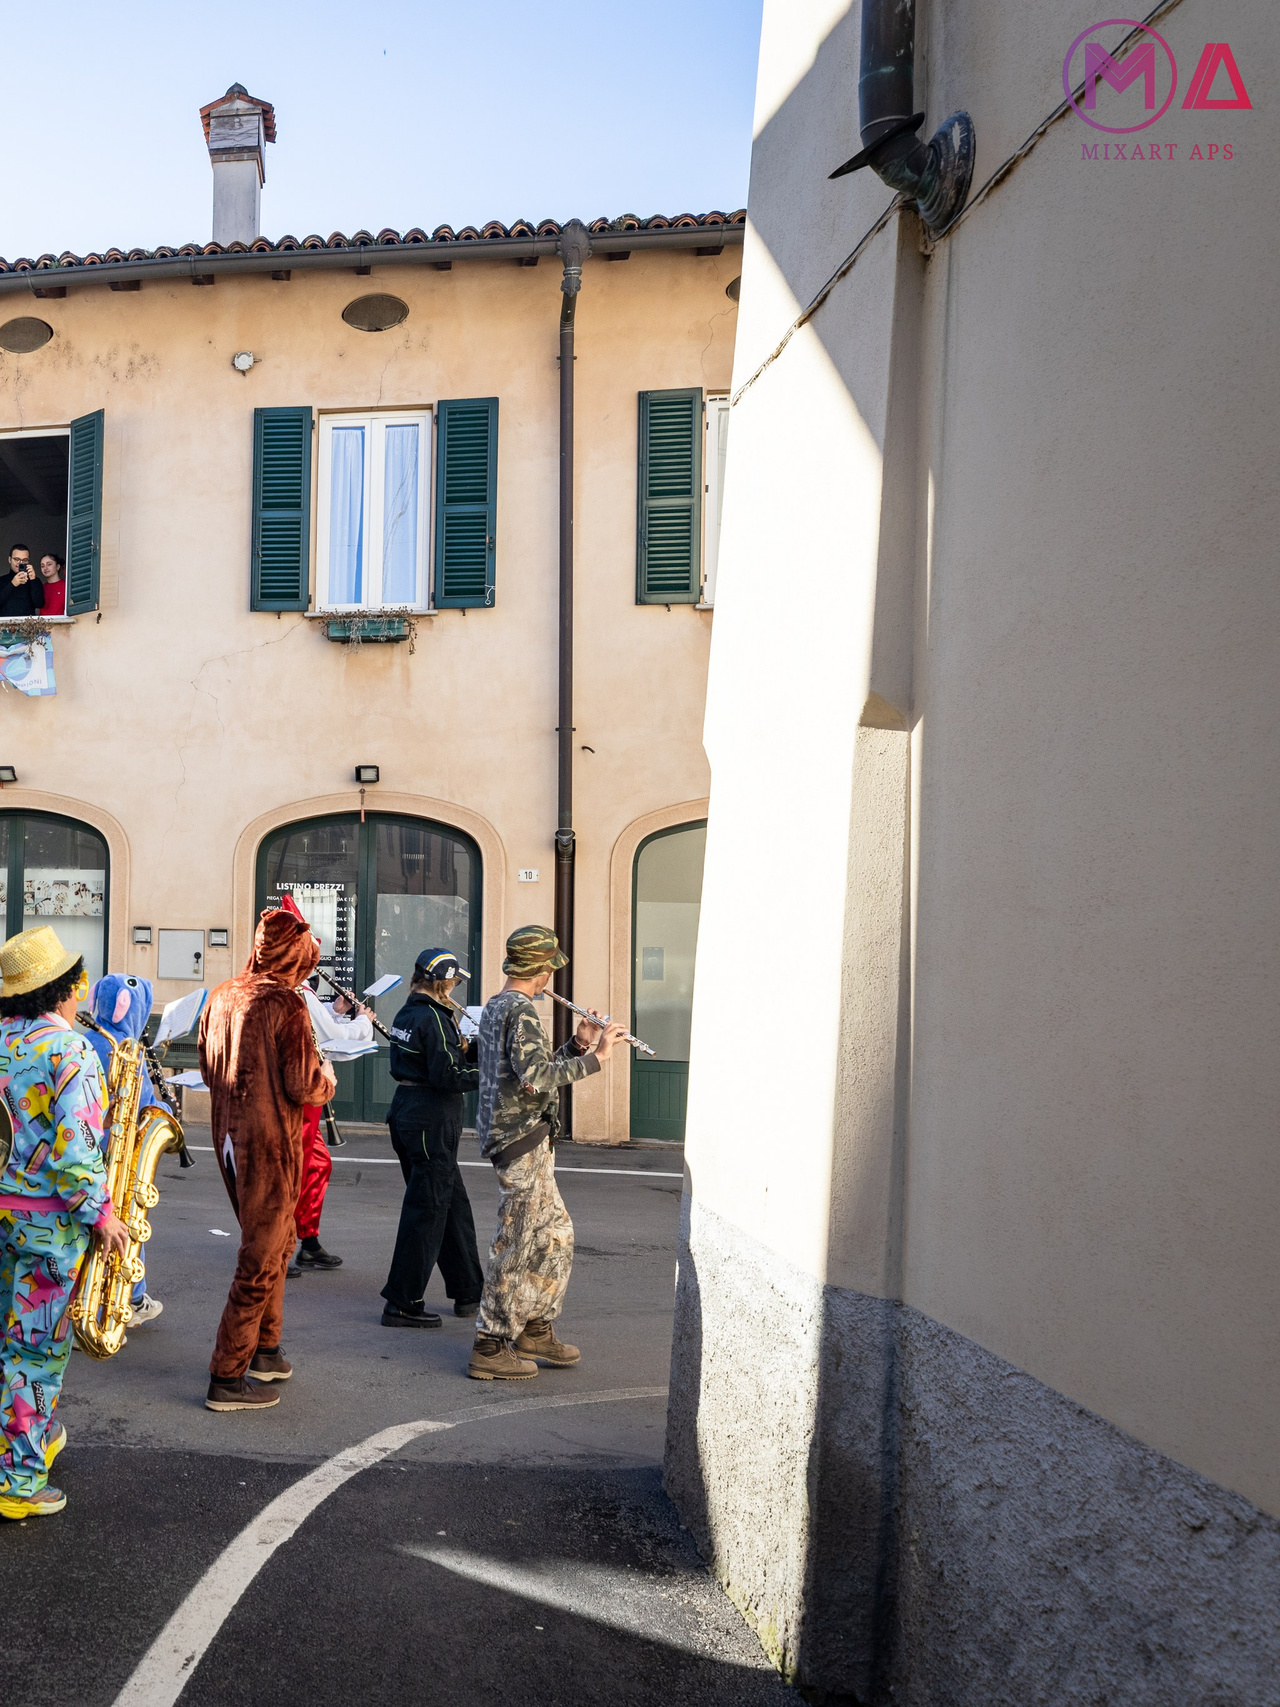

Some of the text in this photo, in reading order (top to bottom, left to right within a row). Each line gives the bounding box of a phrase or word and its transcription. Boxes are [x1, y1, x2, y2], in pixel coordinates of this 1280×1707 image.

[524, 871, 533, 880] 10
[276, 882, 345, 892] LISTINO PREZZI
